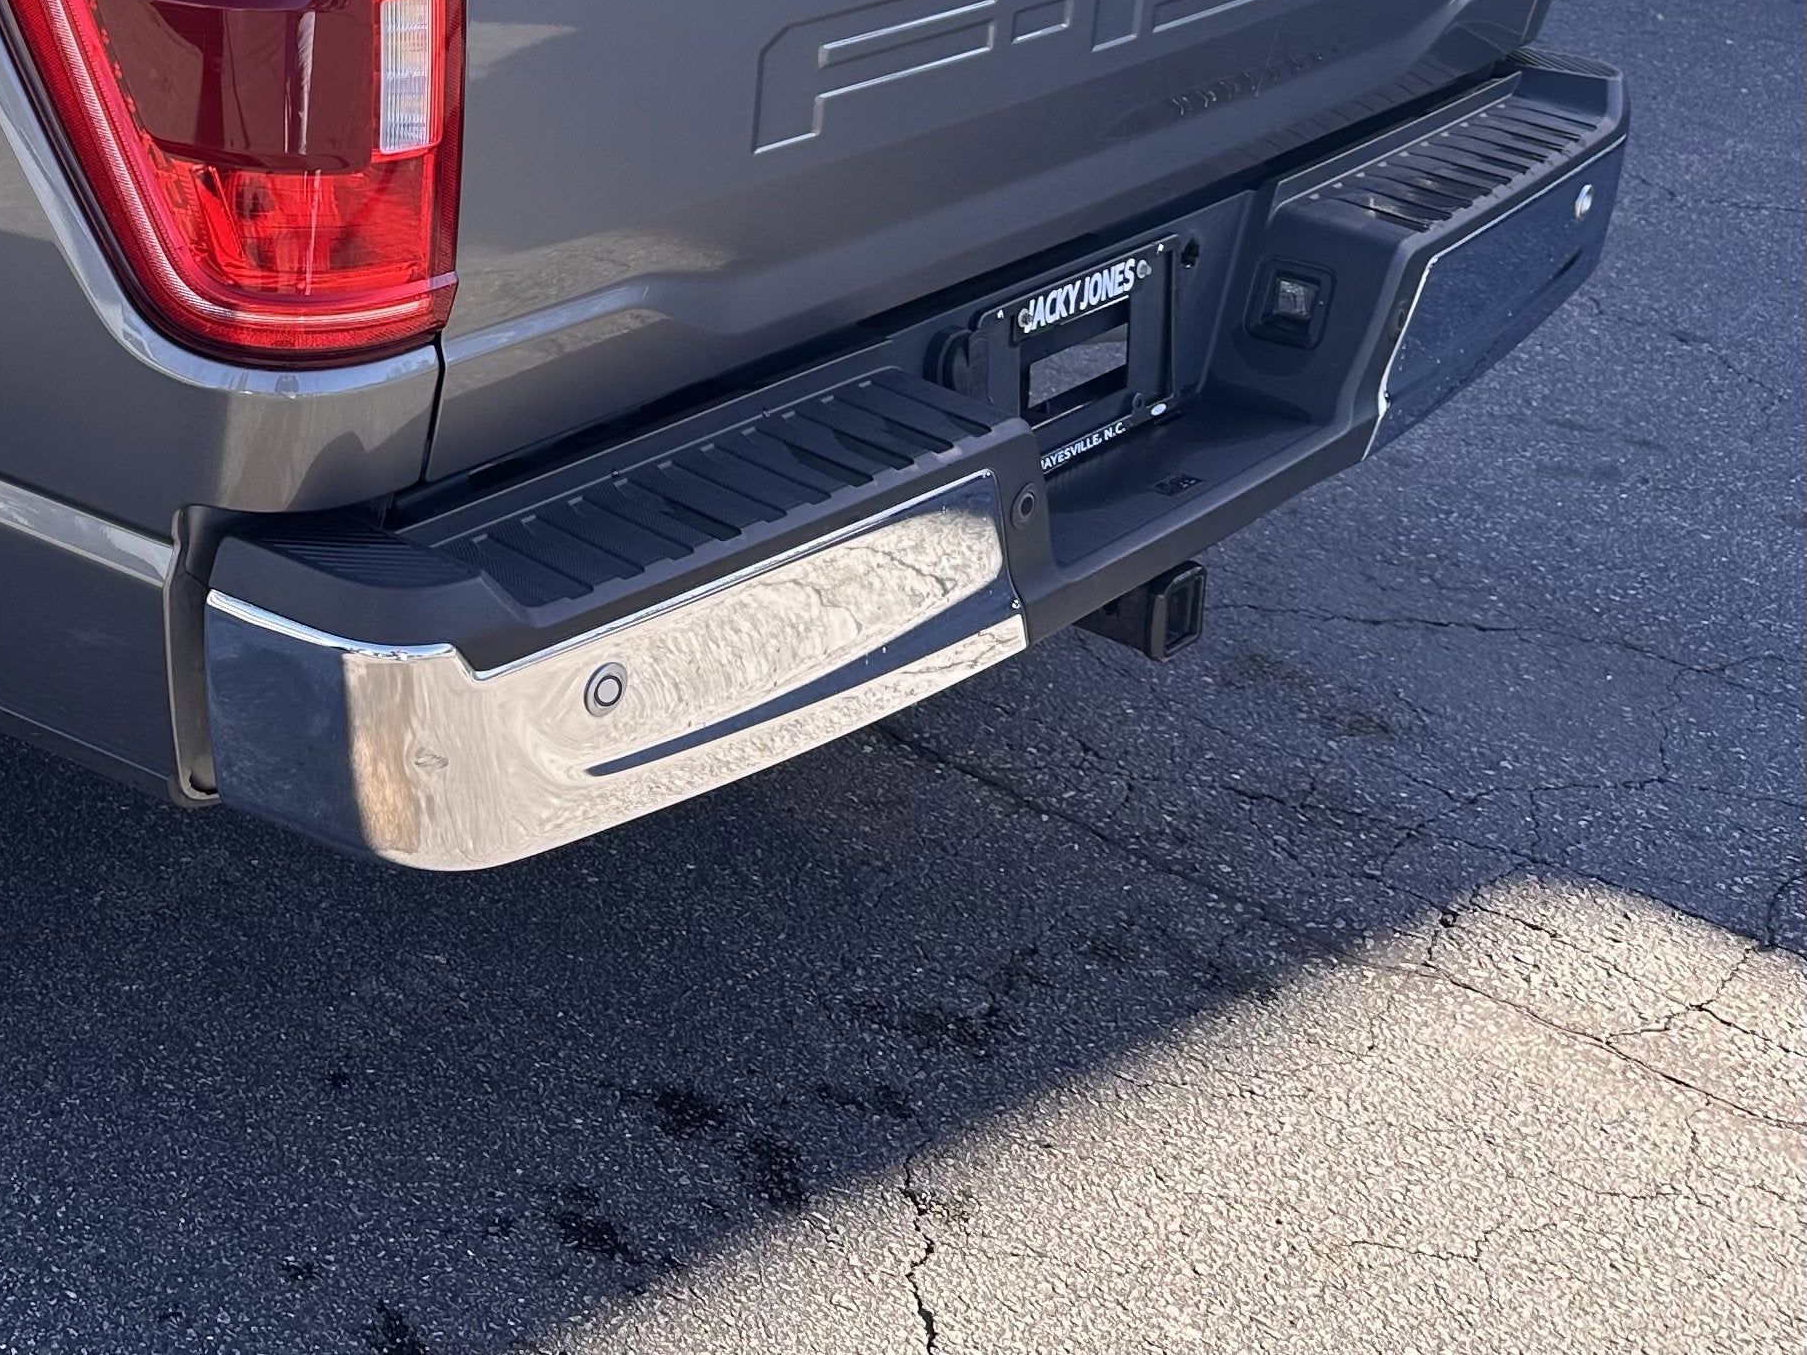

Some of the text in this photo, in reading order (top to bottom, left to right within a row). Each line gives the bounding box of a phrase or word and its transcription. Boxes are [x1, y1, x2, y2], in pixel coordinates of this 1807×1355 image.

[1023, 258, 1136, 334] JACKY JONES
[1104, 421, 1127, 441] N.C.
